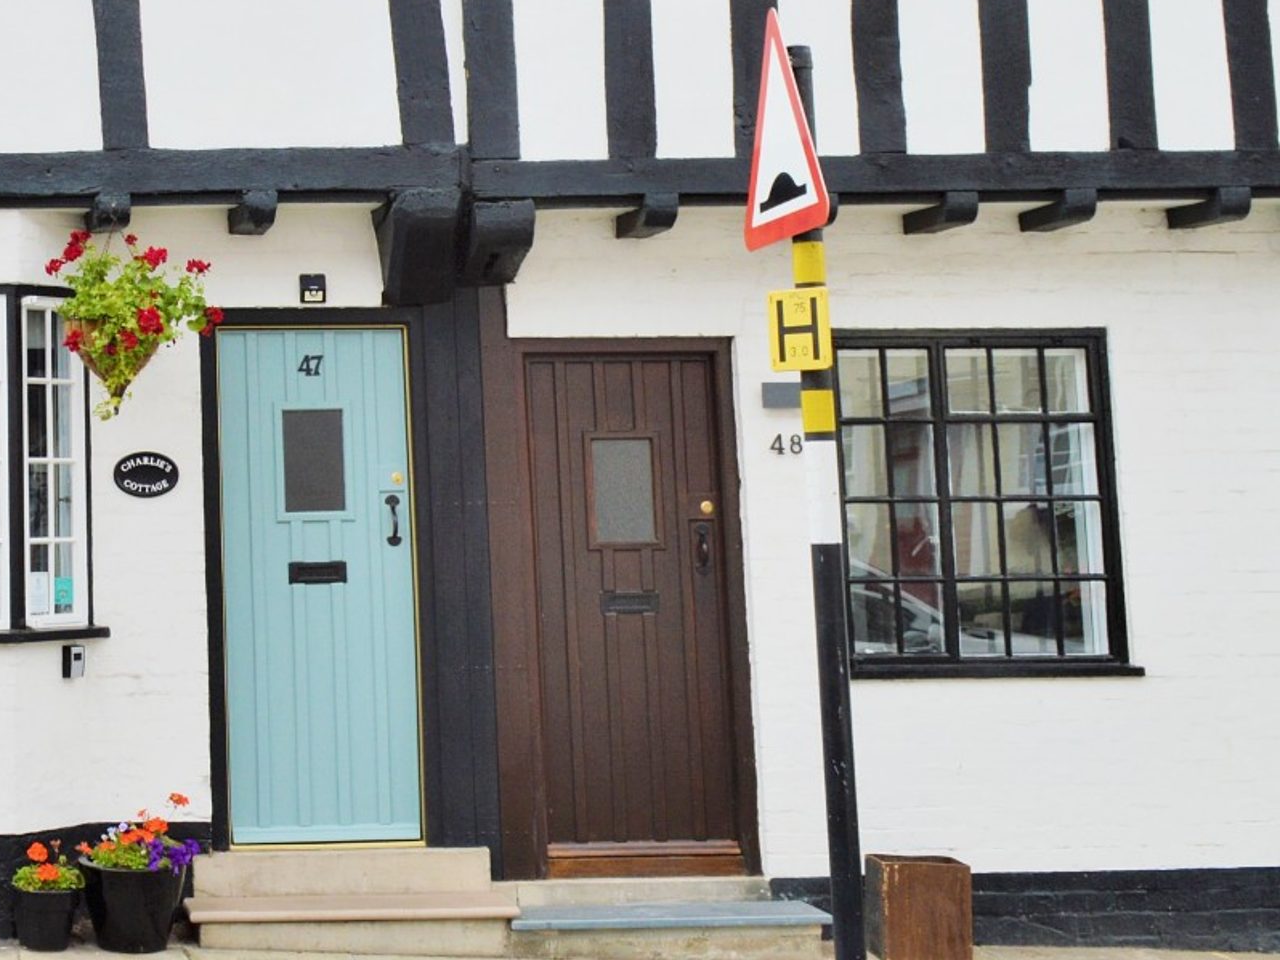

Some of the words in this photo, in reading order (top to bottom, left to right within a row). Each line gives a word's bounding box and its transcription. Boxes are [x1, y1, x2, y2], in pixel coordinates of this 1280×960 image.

[776, 297, 821, 363] H
[297, 354, 324, 377] 47
[769, 432, 803, 456] 48
[123, 478, 170, 493] COTTAGE
